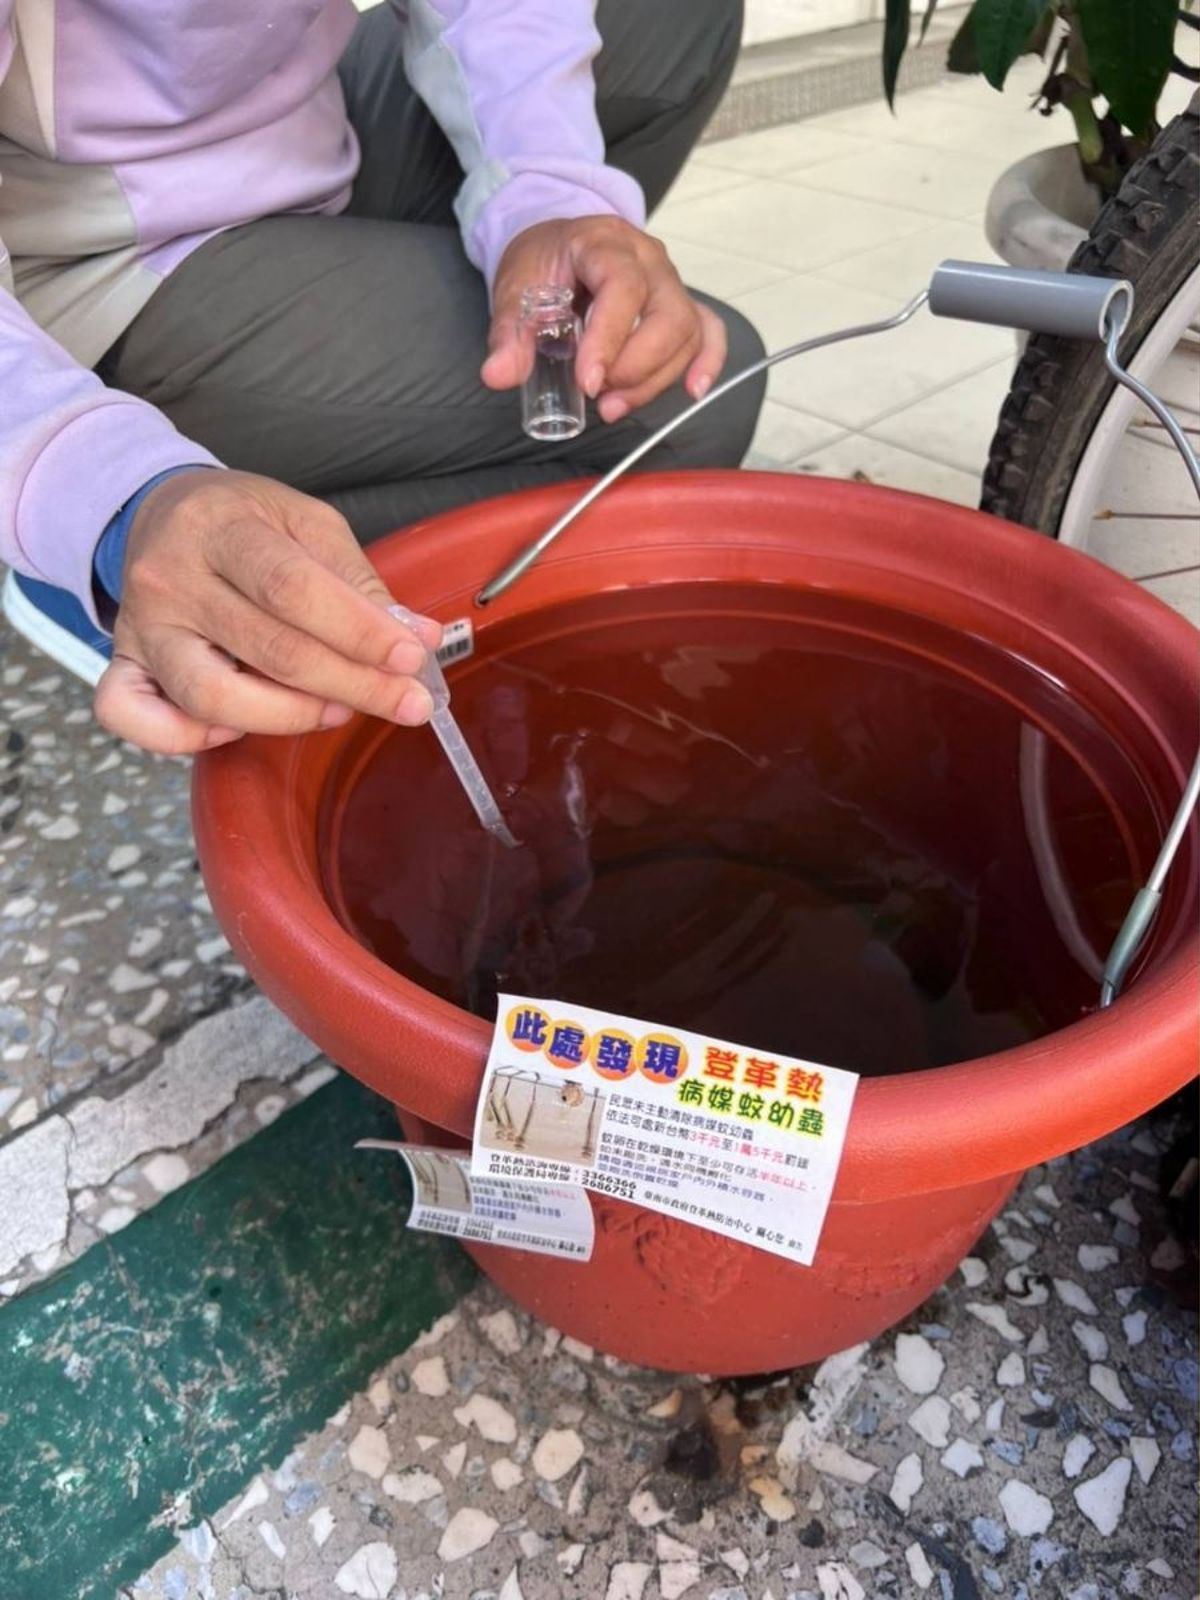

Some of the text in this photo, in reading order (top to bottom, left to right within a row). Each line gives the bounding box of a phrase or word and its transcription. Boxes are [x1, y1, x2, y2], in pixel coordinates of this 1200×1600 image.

[513, 1011, 824, 1102] 此處發現 登革熱
[678, 1079, 824, 1137] 病媒蚊幼蟲
